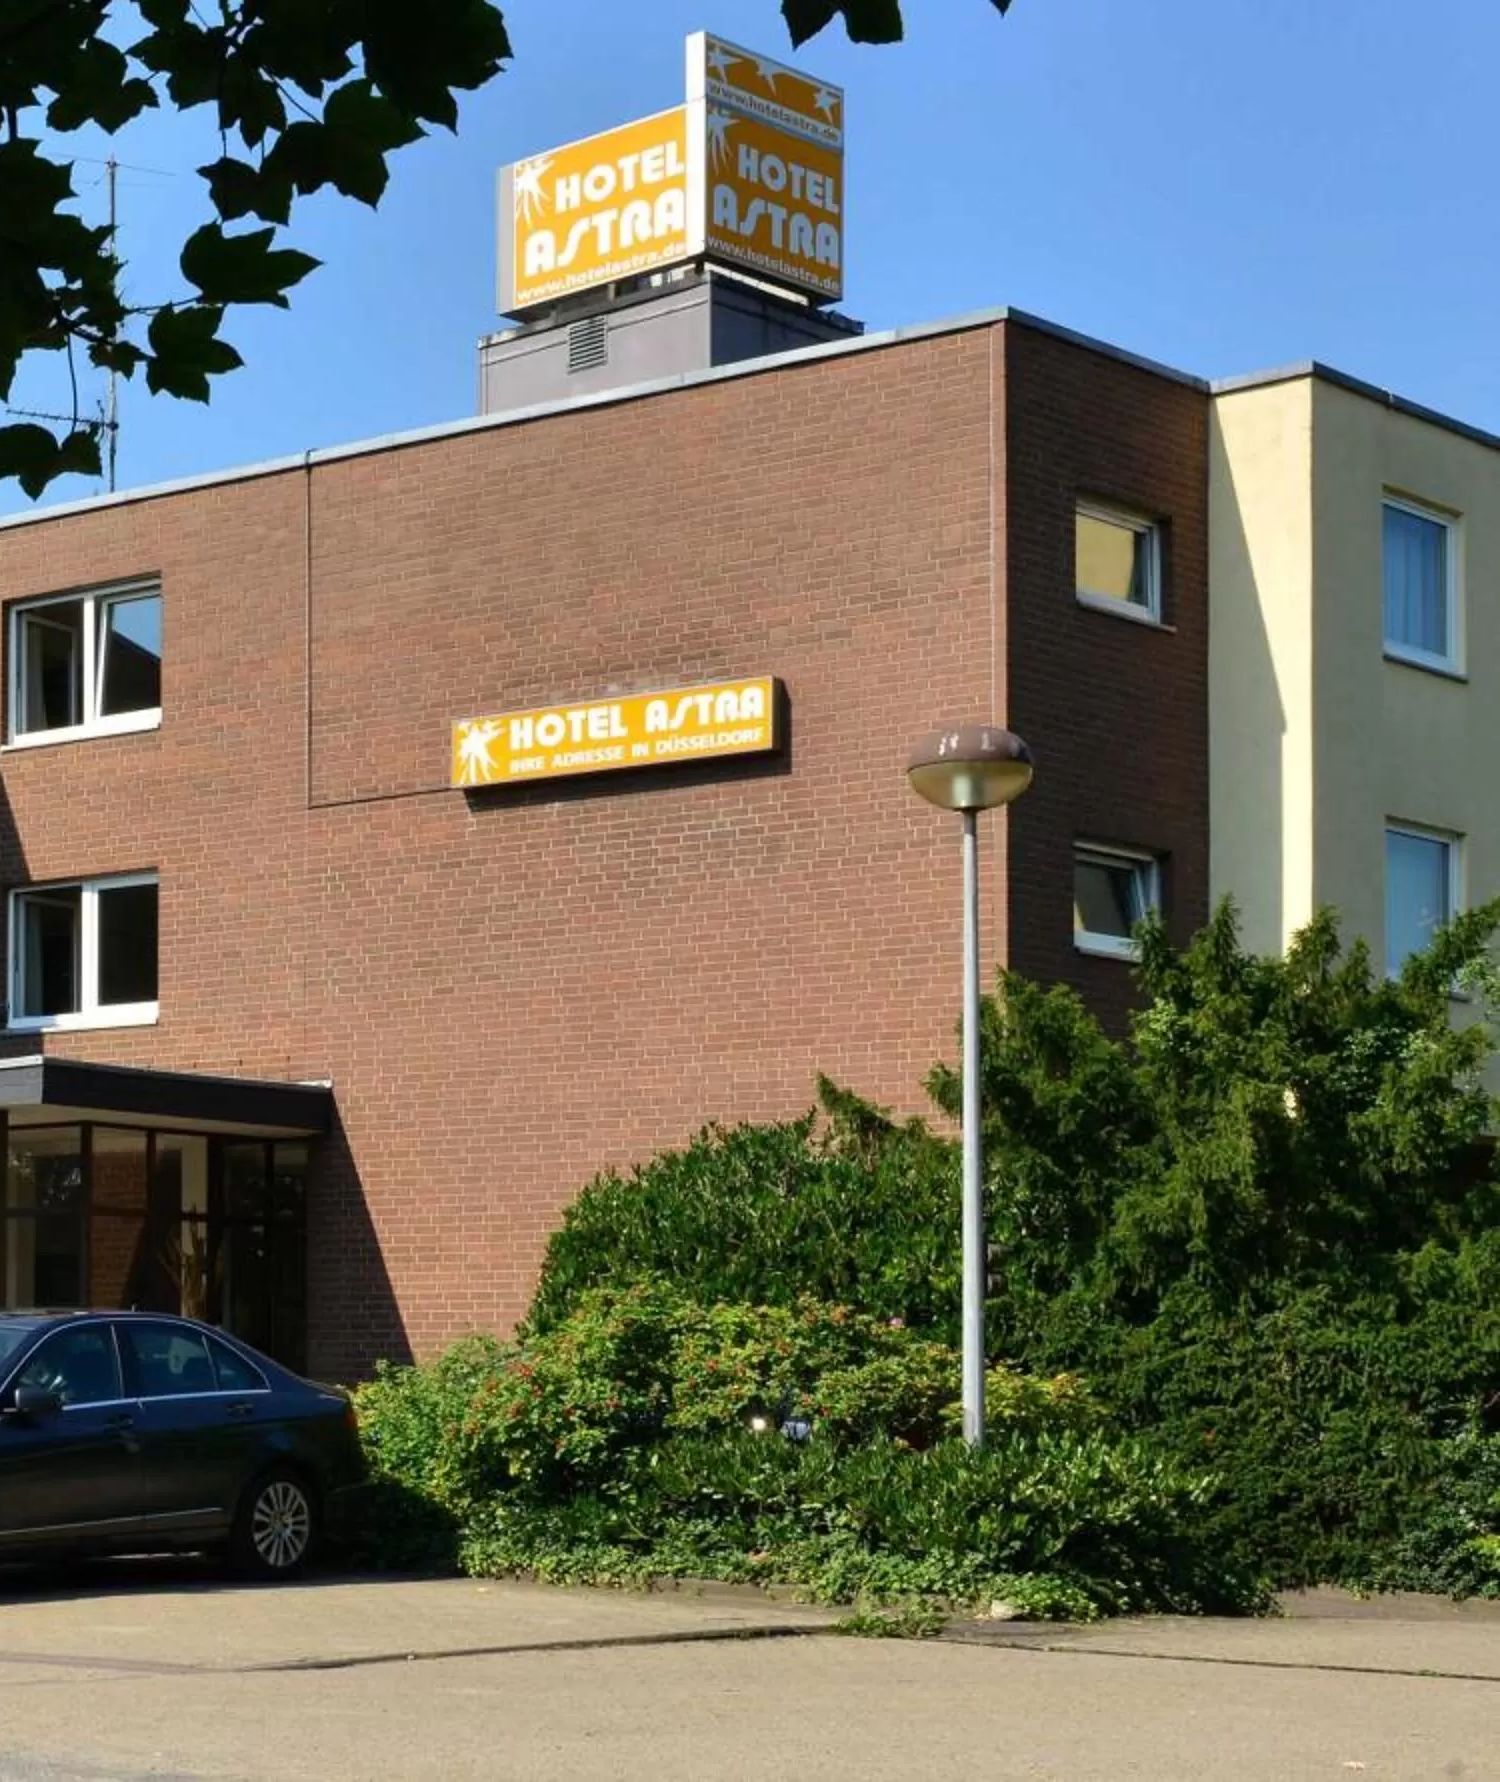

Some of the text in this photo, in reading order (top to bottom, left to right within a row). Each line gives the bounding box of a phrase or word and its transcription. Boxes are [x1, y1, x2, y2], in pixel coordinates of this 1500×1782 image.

[706, 79, 840, 143] www.hotelastra.de
[554, 140, 686, 214] HOTEL
[737, 143, 839, 214] HOTEL
[524, 188, 686, 278] ASTRA
[712, 183, 840, 269] ASTRA
[515, 242, 688, 302] www.hotelastra.de
[706, 234, 840, 292] www.hotelastra.de
[510, 686, 765, 751] HOTEL ASTRA
[551, 744, 625, 769] ADRESSE
[631, 742, 649, 757] IN
[655, 726, 765, 755] DÜSSELDORF
